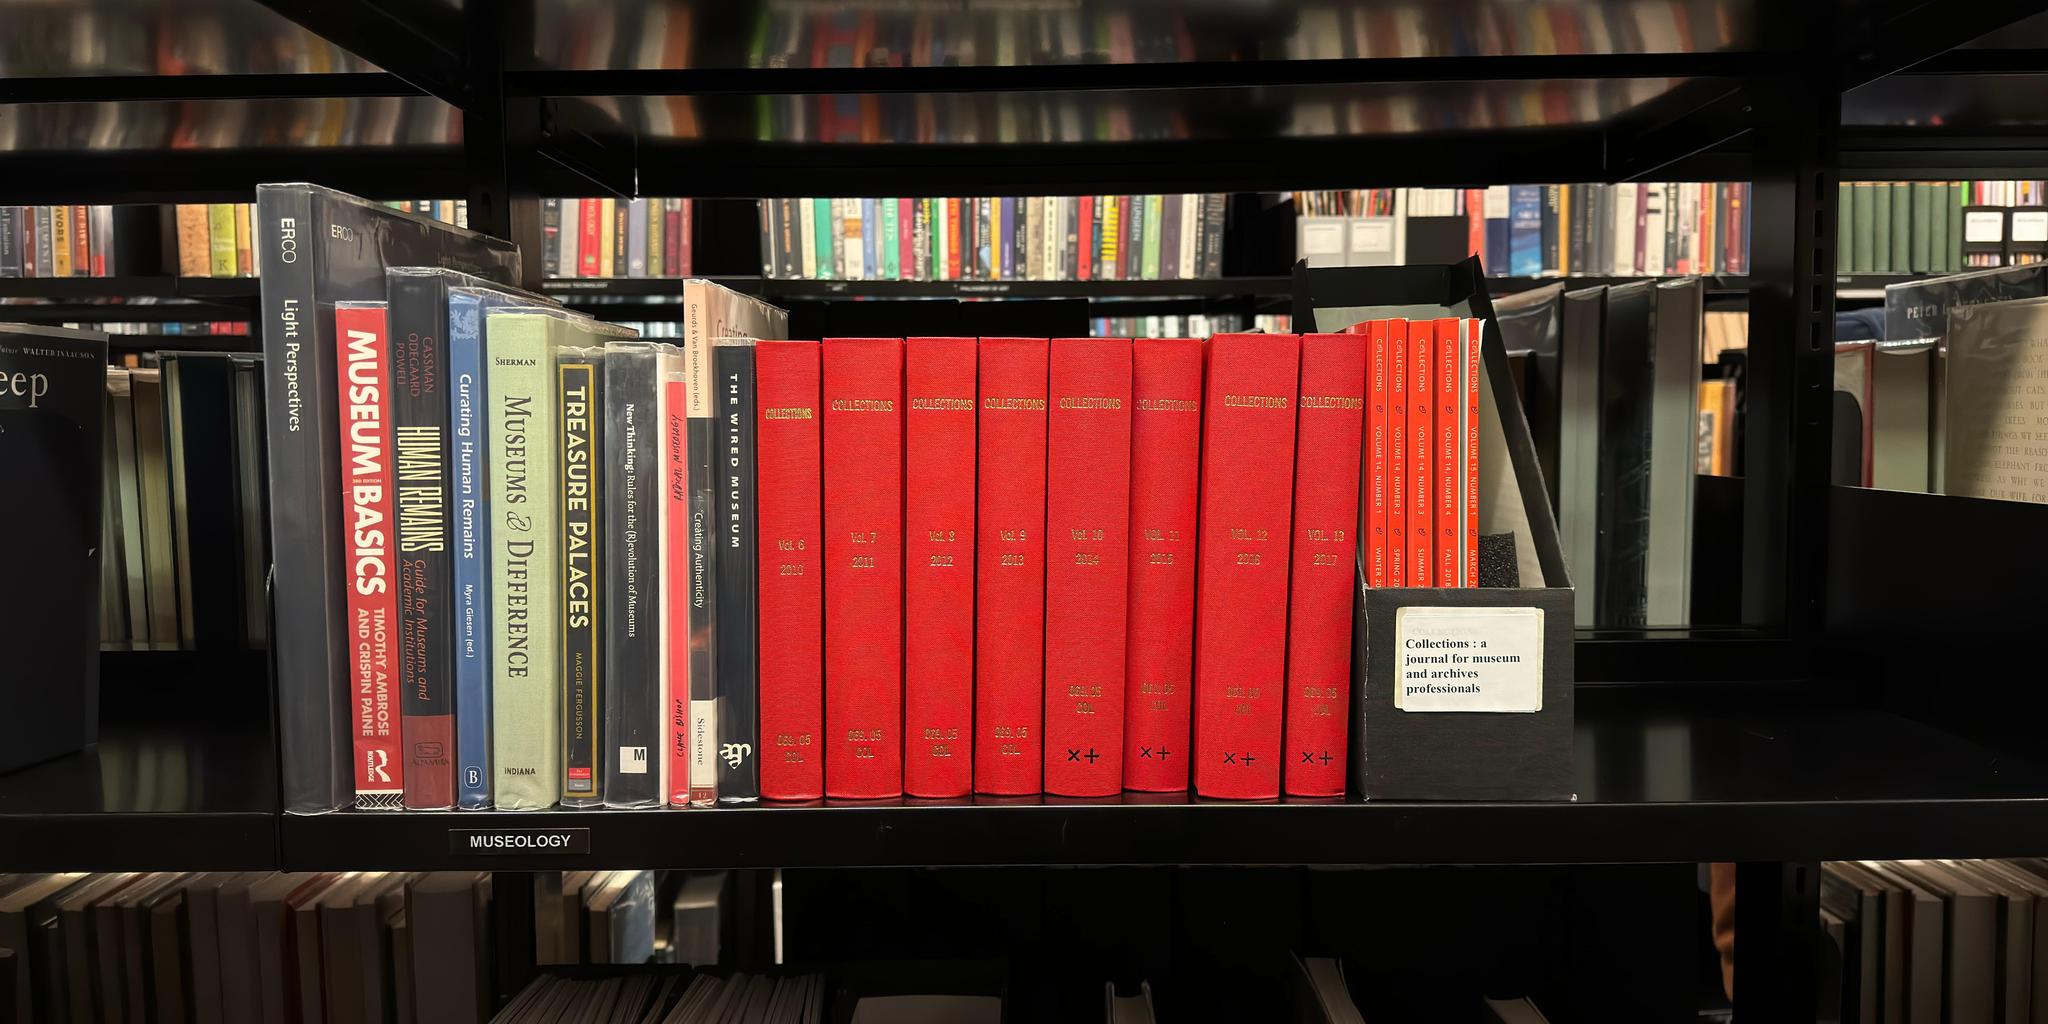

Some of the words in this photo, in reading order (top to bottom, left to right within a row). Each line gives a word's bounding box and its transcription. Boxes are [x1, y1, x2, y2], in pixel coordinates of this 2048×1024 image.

[281, 217, 297, 264] ERCO
[331, 224, 354, 242] ERCO
[281, 299, 298, 338] Light
[23, 346, 55, 357] WALTER
[397, 342, 406, 386] POWELL
[408, 332, 421, 398] ODEGAARD
[423, 336, 434, 394] CASSMAN
[692, 350, 700, 392] Broekhoven
[283, 342, 303, 432] Perspectives
[730, 373, 738, 405] THE
[347, 329, 382, 476] MUSEUM
[458, 373, 472, 437] Curating
[832, 399, 893, 412] COLLECTIONS
[912, 398, 973, 411] COLLECTIONS
[984, 398, 1045, 410] COLLECTIONS
[1059, 397, 1121, 410] COLLECTIONS
[1137, 399, 1197, 412] COLLECTIONS
[1224, 394, 1288, 409] COLLECTIONS
[1300, 396, 1363, 410] COLLECTIONS
[626, 403, 635, 424] New
[765, 407, 813, 420] COLLECTIONS
[566, 386, 588, 511] TREASURE
[624, 424, 636, 474] Thinking:
[671, 414, 685, 464] MUSEOLOGY
[730, 413, 739, 467] WIRED
[397, 426, 442, 480] HUMAN
[461, 441, 474, 495] Human
[627, 475, 636, 499] Rules
[627, 500, 637, 513] for
[731, 476, 740, 548] MUSEUM
[399, 486, 444, 552] REMAINS
[462, 499, 476, 559] Remains
[506, 511, 532, 532] &
[628, 513, 637, 529] the
[353, 485, 387, 596] BASICS
[692, 512, 704, 551] Creating
[870, 532, 877, 543] 7
[949, 530, 955, 542] 8
[1019, 530, 1026, 541] 9
[1092, 529, 1104, 541] 10
[1169, 530, 1180, 541] 11
[1256, 529, 1268, 541] 12
[1333, 530, 1345, 542] 13
[798, 539, 805, 551] 6
[625, 530, 638, 583] (R)evolution
[852, 556, 875, 568] 2011
[930, 555, 953, 567] 2012
[1001, 554, 1024, 566] 2013
[1075, 553, 1099, 566] 2014
[1150, 553, 1173, 566] 2015
[1237, 553, 1261, 566] 2016
[1314, 554, 1338, 567] 2017
[414, 559, 426, 594] Guide
[569, 521, 589, 629] PALACES
[694, 553, 704, 609] Authenticity
[780, 564, 804, 576] 2010
[402, 559, 414, 616] Academic
[464, 584, 474, 605] Myra
[628, 584, 638, 595] of
[415, 598, 428, 620] for
[628, 595, 637, 638] Museums
[357, 608, 370, 640] AND
[465, 606, 474, 637] Giesen
[373, 608, 386, 670] TIMOTHY
[416, 620, 429, 676] Museums
[465, 638, 474, 658] (ed.)
[1405, 638, 1469, 649] Collections
[1480, 641, 1487, 649] a
[404, 618, 414, 684] Institutions
[1405, 653, 1448, 665] journal
[1452, 653, 1469, 664] for
[359, 642, 372, 694] CRISPIN
[575, 652, 583, 686] MAGGIE
[1406, 668, 1428, 679] and
[1431, 668, 1479, 679] archives
[417, 679, 430, 701] and
[1406, 683, 1481, 696] professionals
[375, 671, 390, 737] AMBROSE
[575, 686, 583, 740] FERGUSSON
[675, 699, 684, 727] BISHOP
[361, 695, 373, 737] PAINE
[633, 748, 645, 761] M
[367, 750, 375, 783] ROUTLEDGE
[469, 770, 478, 784] B
[504, 767, 536, 776] INDIANA
[470, 834, 571, 849] MUSEOLOGY
